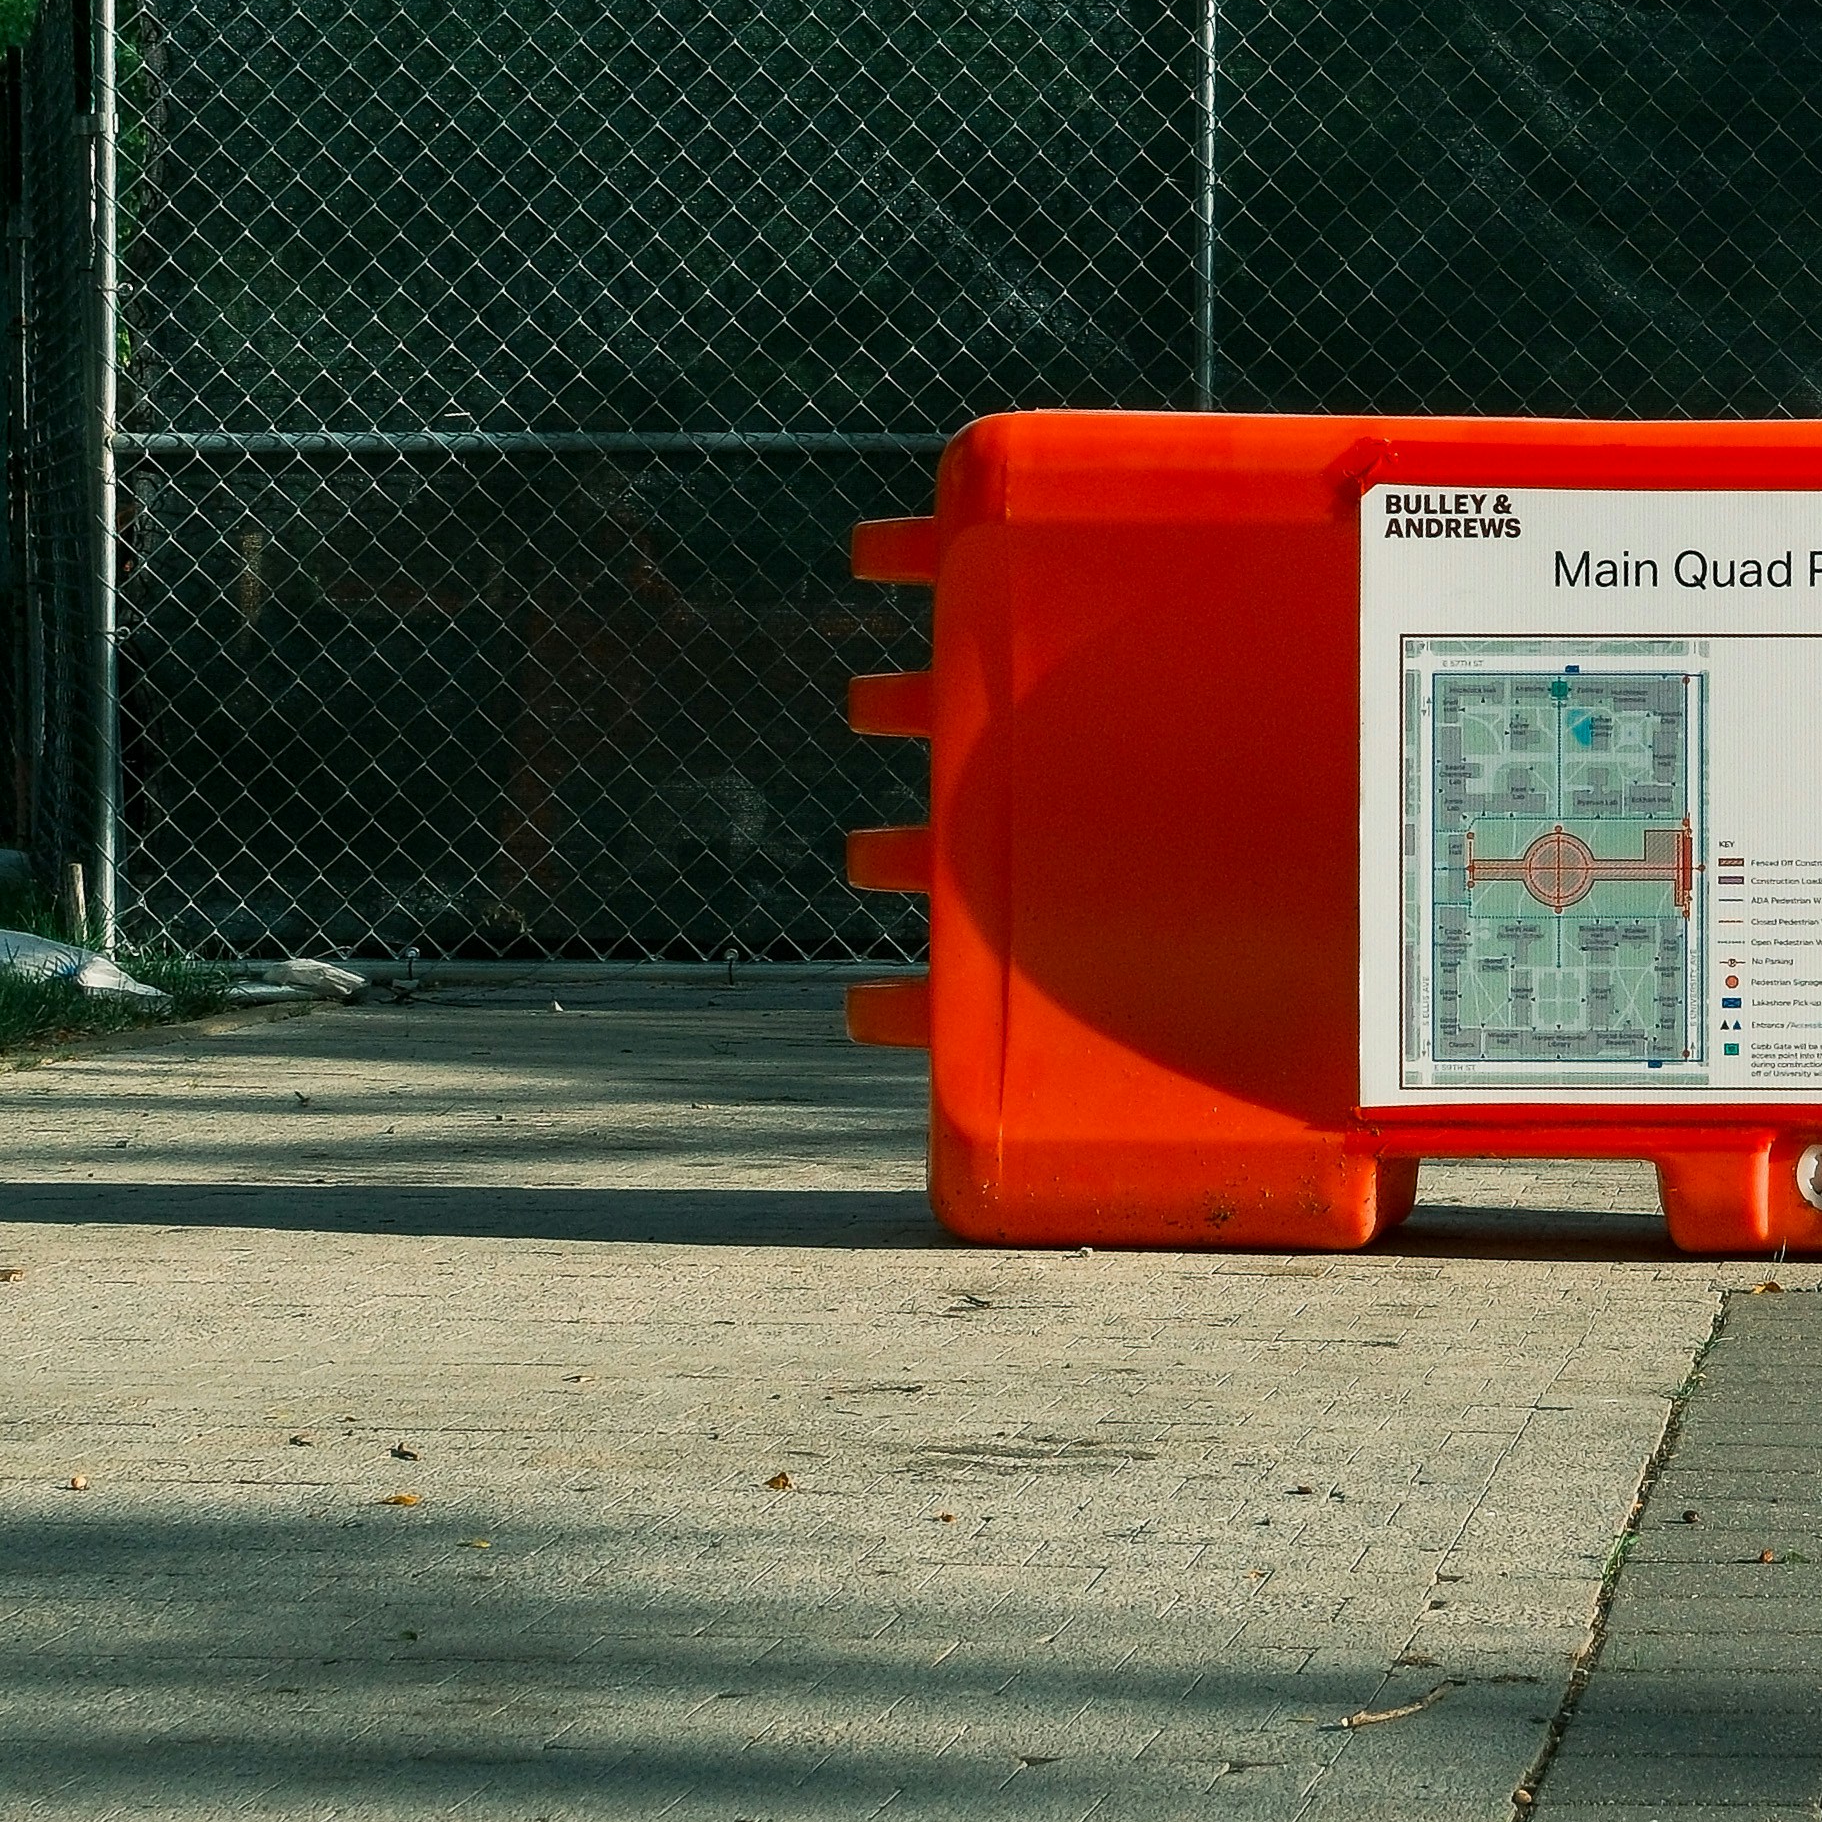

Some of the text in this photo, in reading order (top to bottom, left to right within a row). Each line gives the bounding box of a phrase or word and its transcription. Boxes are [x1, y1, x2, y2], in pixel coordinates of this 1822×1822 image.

[1384, 494, 1512, 515] BULLEY &
[1384, 518, 1521, 538] ANDREWS
[1554, 550, 1658, 588] Main
[1673, 550, 1792, 590] Quad
[1718, 840, 1735, 848] KEY
[1751, 859, 1779, 867] Fenced
[1780, 859, 1794, 867] Off
[1750, 918, 1777, 926] Closed
[1778, 918, 1819, 926] Pedestrian
[1750, 939, 1772, 947] Open
[1765, 958, 1794, 966] Parking
[1422, 976, 1430, 993] AVE
[1422, 995, 1430, 1019] ELLIS
[1752, 999, 1791, 1007] Lakeshore
[1778, 1052, 1798, 1060] point
[1751, 1061, 1776, 1069] during
[1773, 1070, 1812, 1079] University
